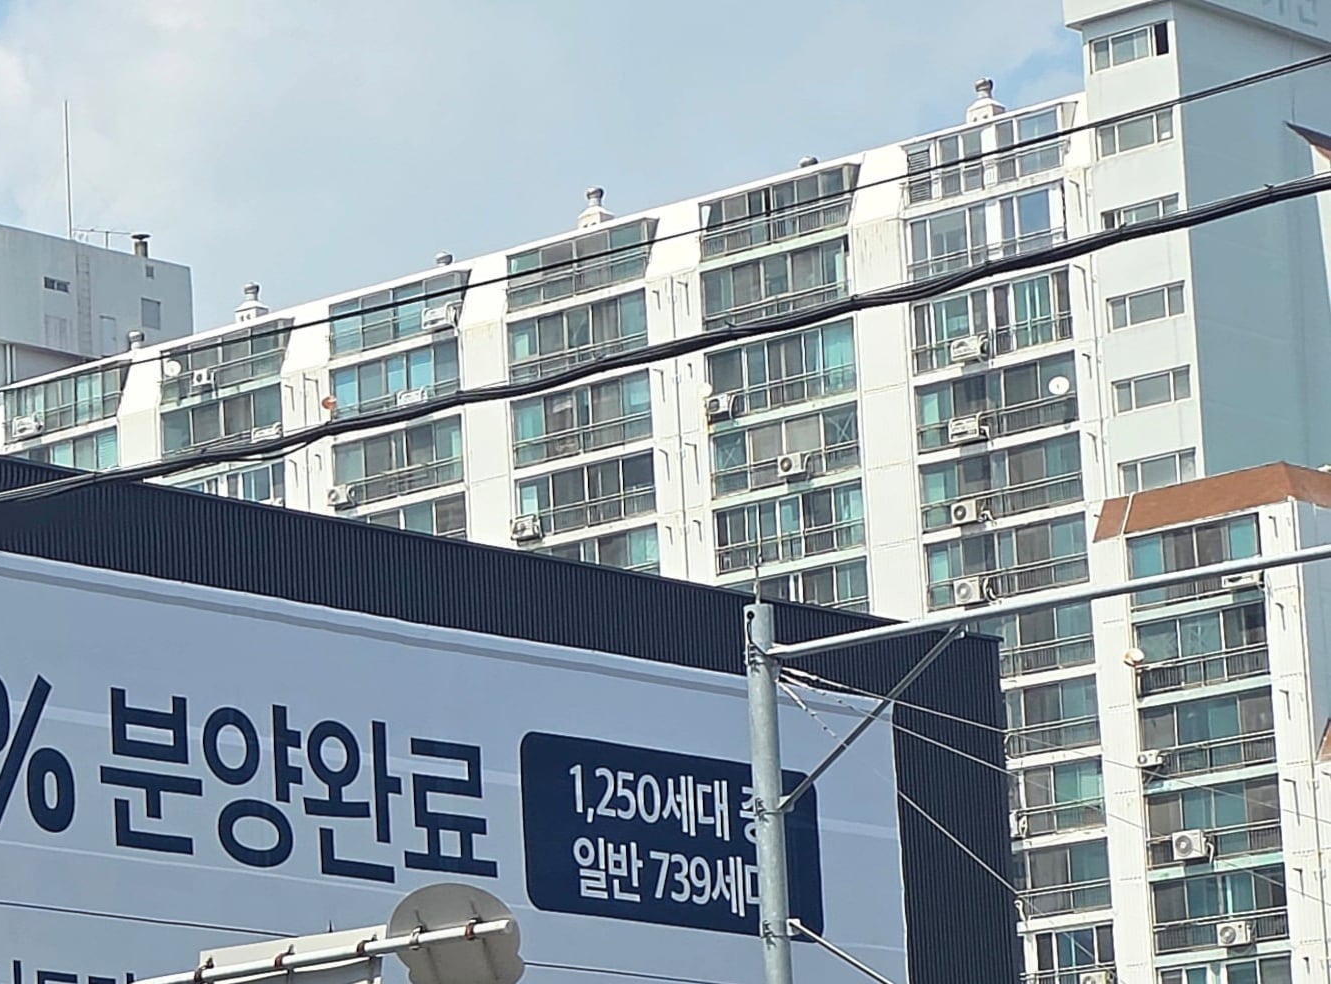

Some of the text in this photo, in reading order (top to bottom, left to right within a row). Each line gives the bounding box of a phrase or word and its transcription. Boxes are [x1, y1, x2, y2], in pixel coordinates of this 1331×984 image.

[99, 686, 499, 885] 분양완료
[569, 764, 731, 841] 1,250세대
[572, 837, 644, 903] 일반
